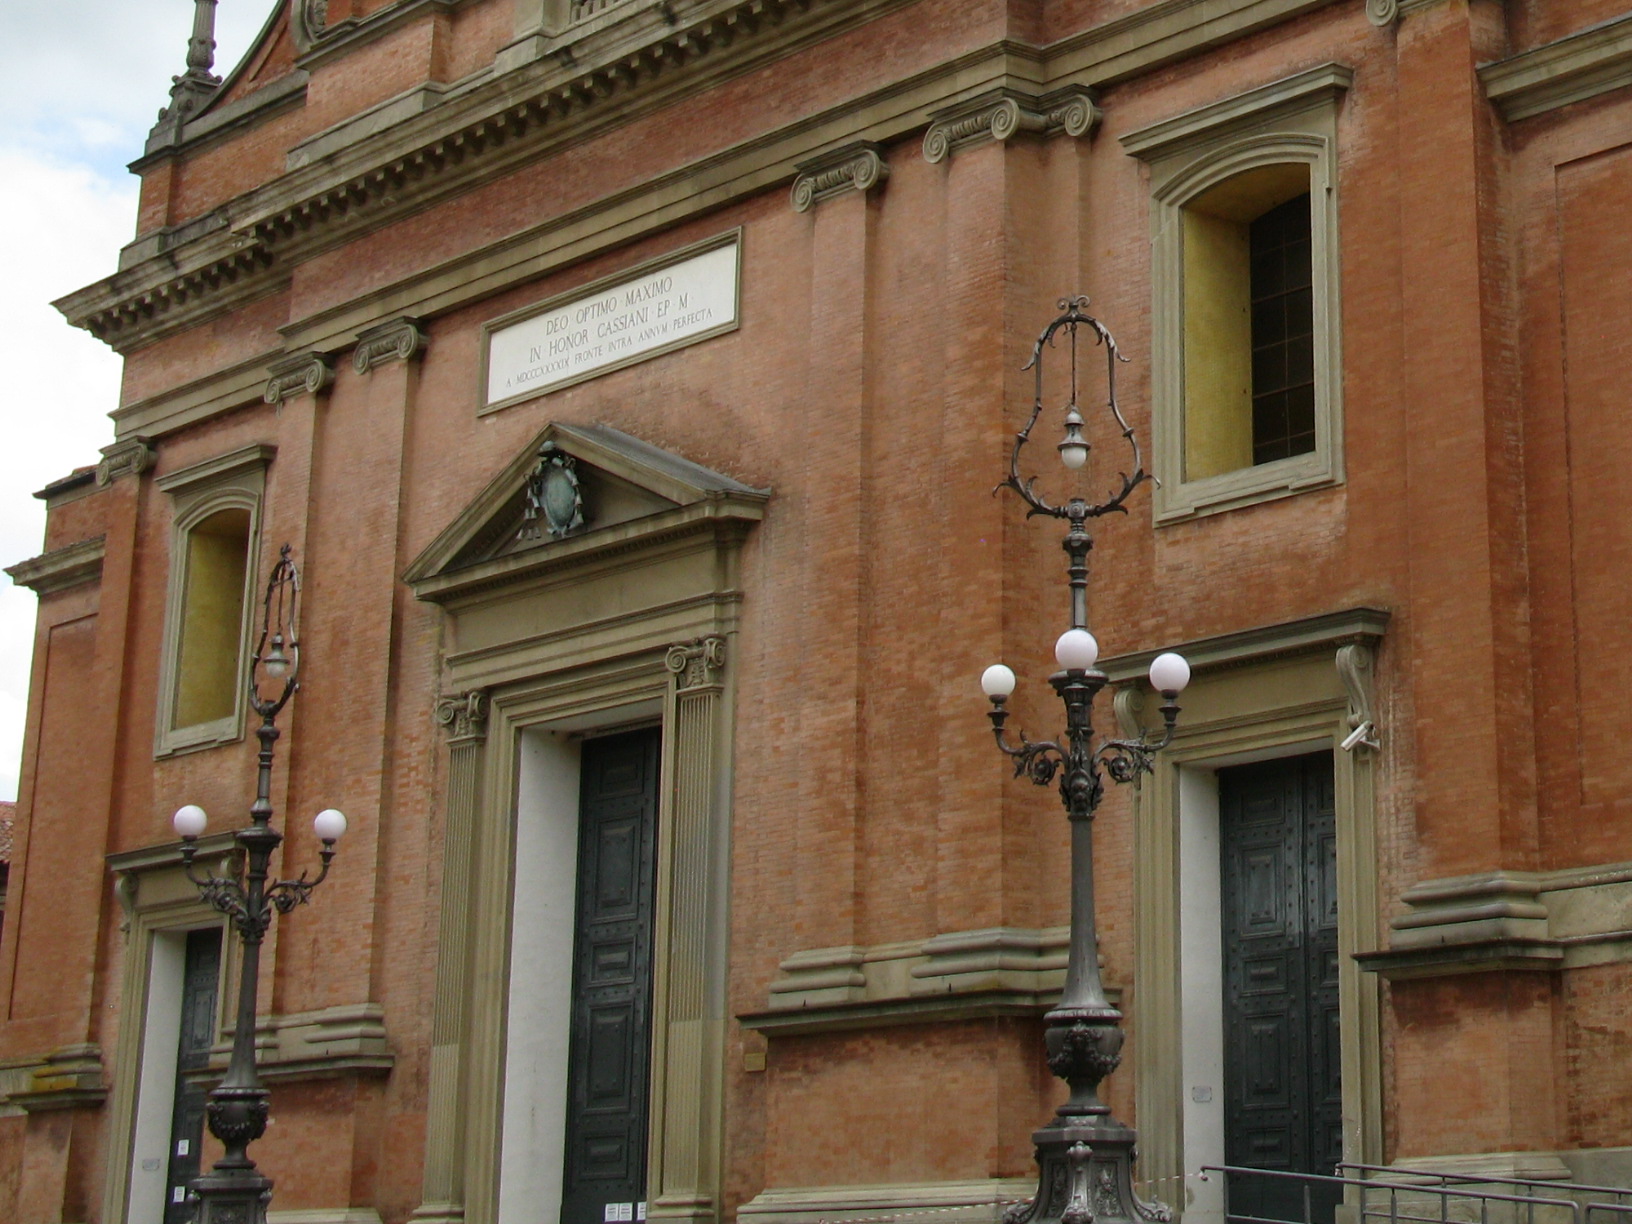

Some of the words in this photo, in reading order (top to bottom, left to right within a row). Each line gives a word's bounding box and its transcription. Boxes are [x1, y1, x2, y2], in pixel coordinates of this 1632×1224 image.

[546, 313, 569, 336] DEO
[576, 297, 617, 325] OPTIMO
[625, 276, 673, 306] MAXIMO
[530, 343, 541, 363] IN
[549, 329, 589, 358] HONOR
[597, 309, 649, 338] CASSIANI
[574, 345, 603, 364] FRONTE
[608, 336, 632, 353] INTRA
[638, 323, 668, 343] ANNVM
[673, 308, 713, 331] PERFECTA
